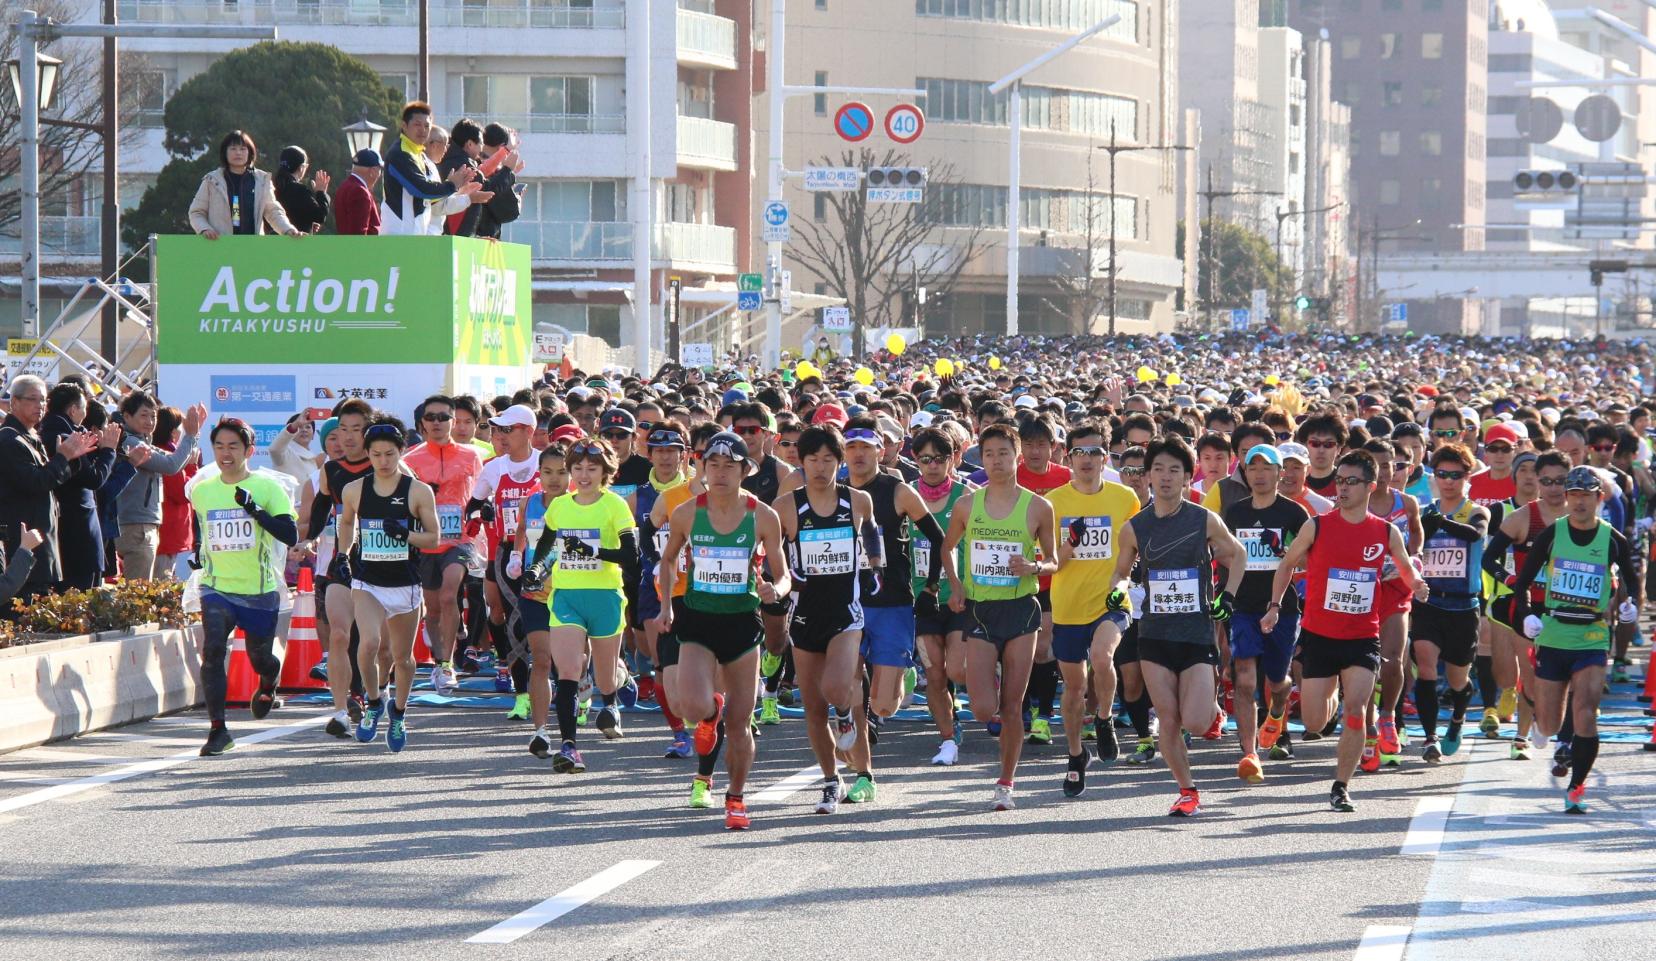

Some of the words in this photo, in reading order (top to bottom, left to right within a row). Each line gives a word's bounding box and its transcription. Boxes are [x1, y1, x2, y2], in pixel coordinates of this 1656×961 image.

[893, 115, 916, 133] 40
[806, 170, 857, 181] 太陽の橋西
[868, 190, 921, 201] 押ボタン式信号
[199, 265, 401, 314] Action!
[199, 318, 326, 333] KITAKYUSHU
[538, 344, 557, 354] 入口
[231, 391, 292, 402] 第一交通産業
[337, 387, 389, 399] 大英産業
[501, 489, 531, 499] 本城陸上ク
[368, 520, 384, 529] 安川
[440, 515, 460, 529] 012
[217, 521, 252, 538] 1010
[971, 528, 1020, 536] MEDIFOAM
[1081, 529, 1109, 547] 030
[823, 542, 832, 553] 2
[1245, 541, 1279, 558] 1003
[807, 552, 850, 565] 川内鮮輝
[991, 554, 999, 565] 3
[1432, 550, 1463, 565] 1079
[717, 560, 723, 571] 1
[1563, 560, 1595, 573] 安川電機
[699, 570, 743, 583] 川内優輝
[1157, 570, 1188, 580] 安川電機
[1338, 570, 1370, 581] 安川電機
[1168, 582, 1177, 592] 4
[1348, 583, 1357, 593] 5
[1562, 572, 1601, 594] 10148
[1154, 593, 1195, 604] 塚本秀志
[1331, 591, 1369, 604] 河野健一
